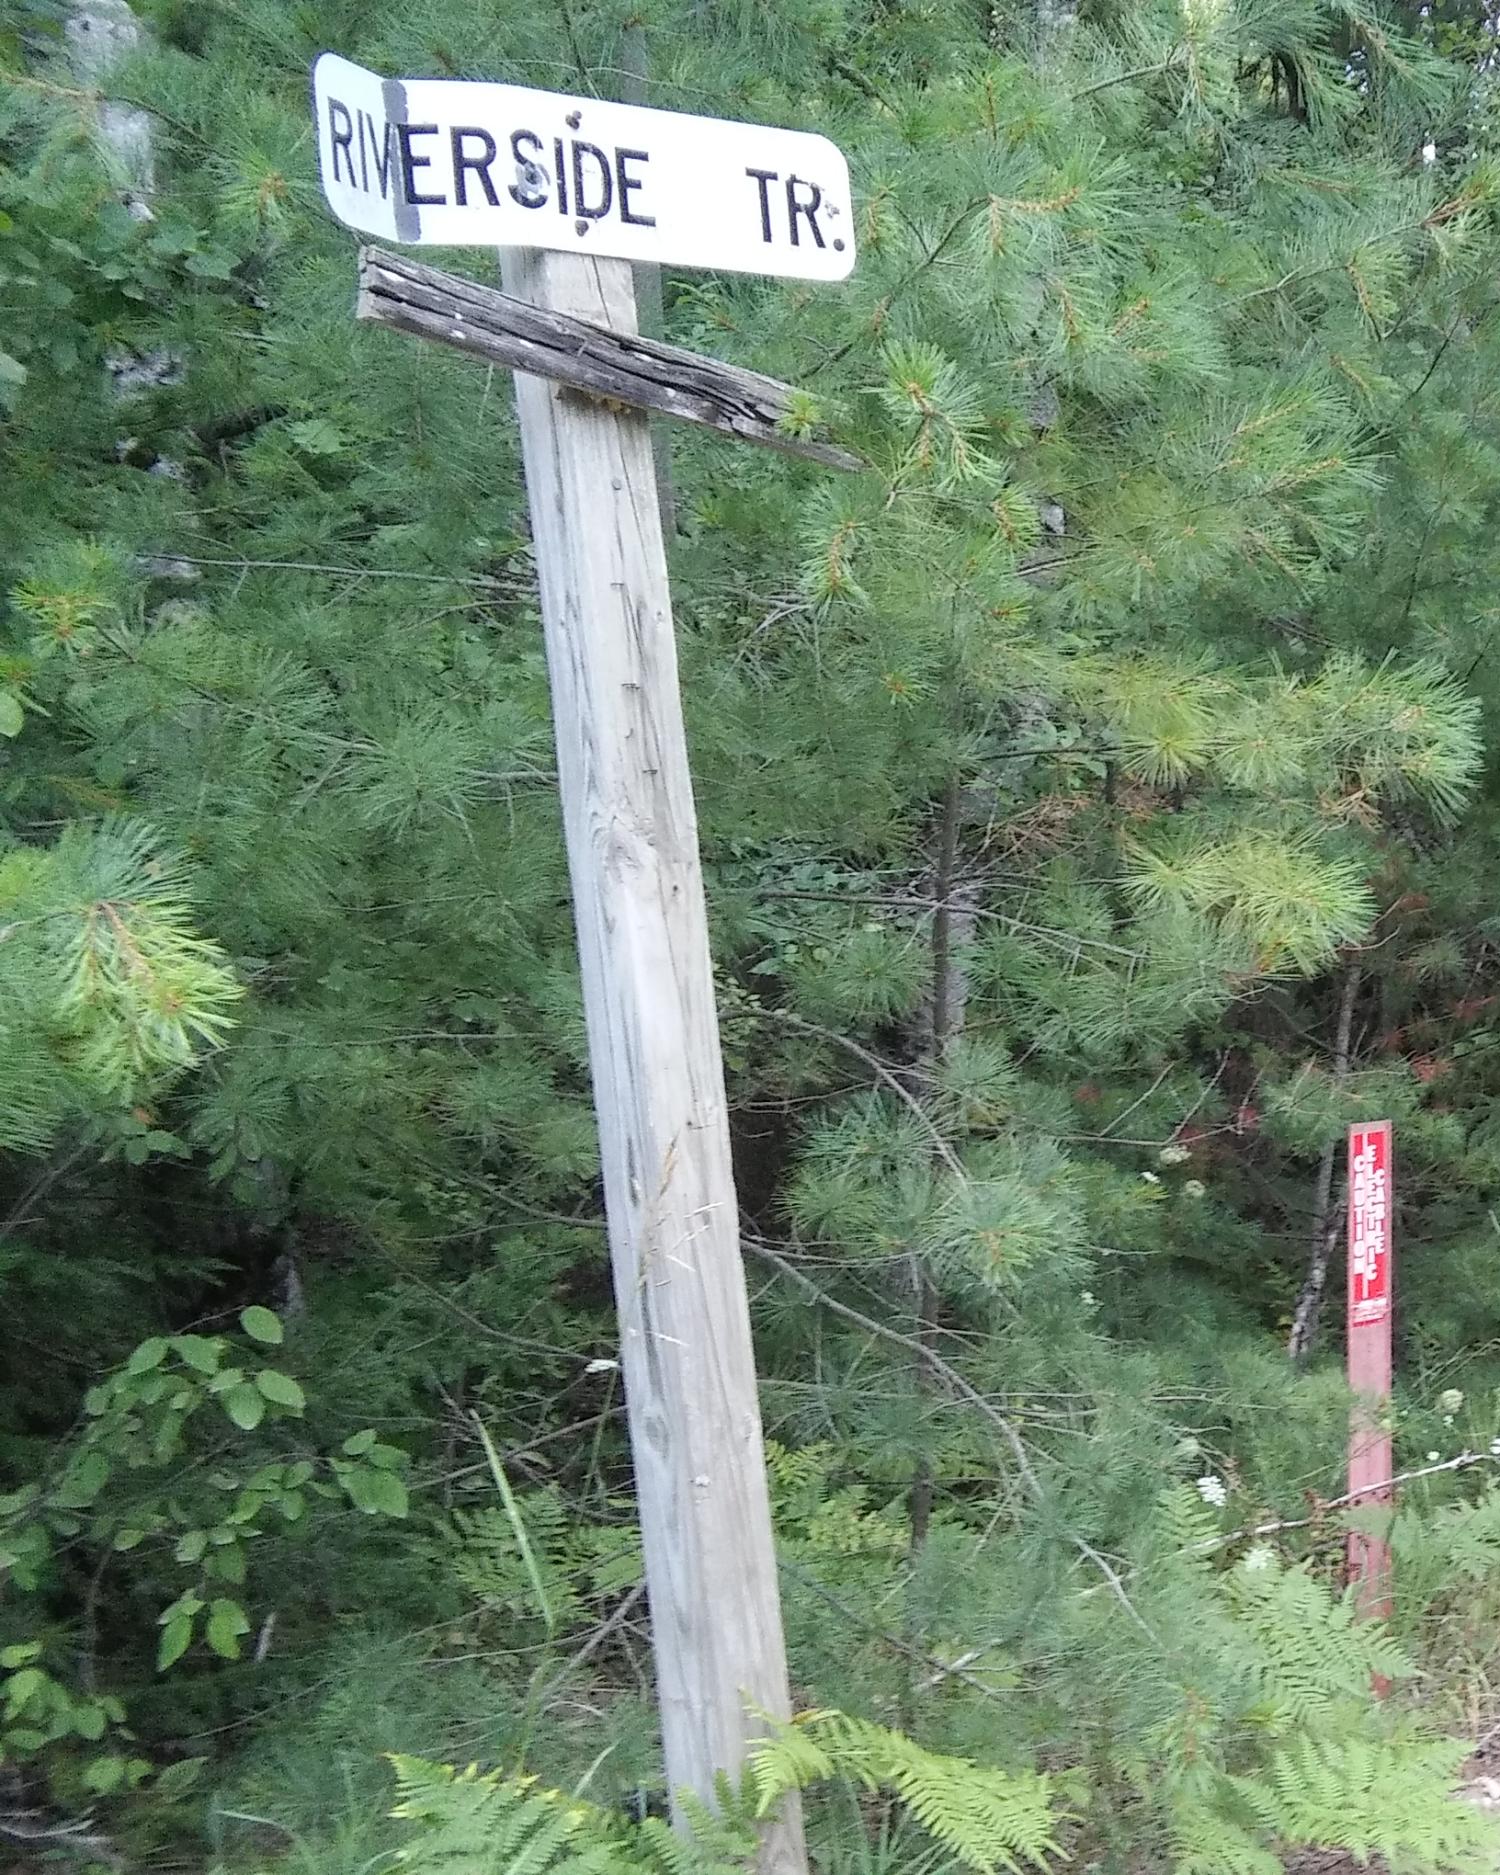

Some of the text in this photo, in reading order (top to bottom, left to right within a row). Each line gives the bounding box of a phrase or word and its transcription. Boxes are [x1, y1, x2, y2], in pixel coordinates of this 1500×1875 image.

[327, 96, 656, 227] RIVERSIDE
[1354, 1155, 1365, 1274] CAUTION
[1367, 1145, 1378, 1281] ELECTRIC
